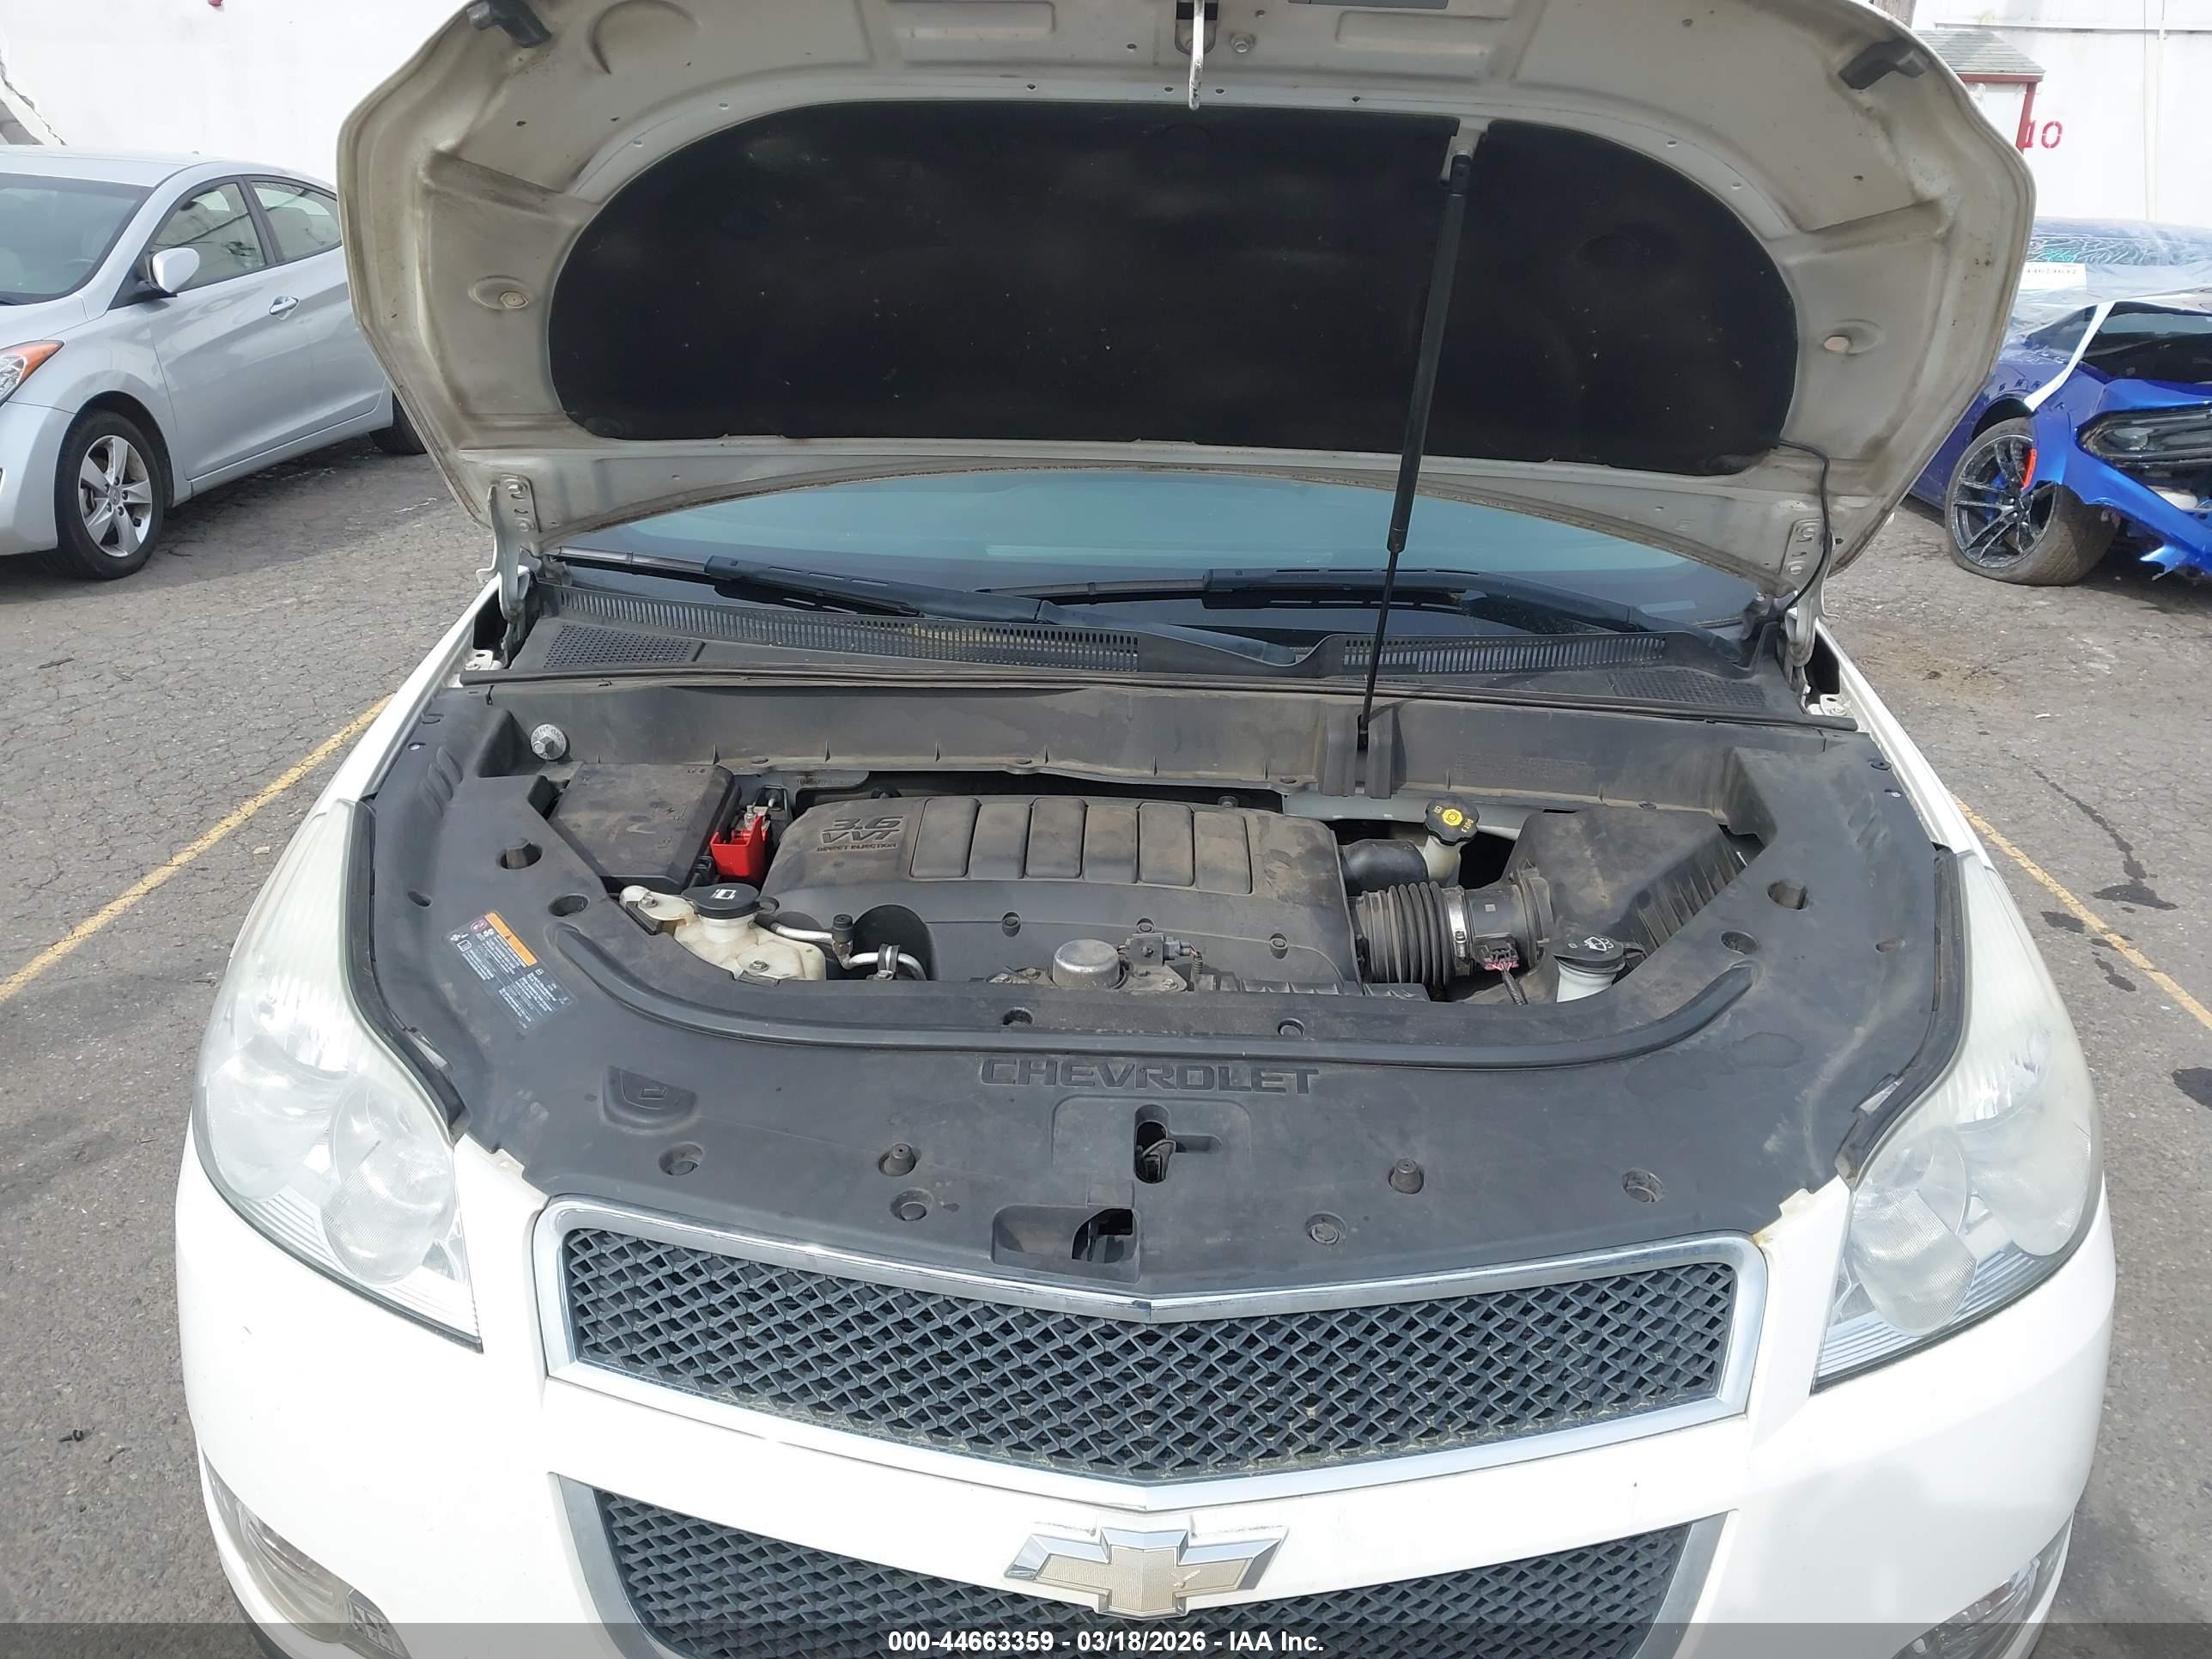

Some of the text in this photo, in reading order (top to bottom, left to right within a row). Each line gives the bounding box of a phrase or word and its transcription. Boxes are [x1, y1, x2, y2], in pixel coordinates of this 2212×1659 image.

[2024, 120, 2063, 149] 10
[833, 816, 903, 830] 3.6
[822, 830, 900, 843] VVT
[981, 1057, 1320, 1095] CHEVROLET
